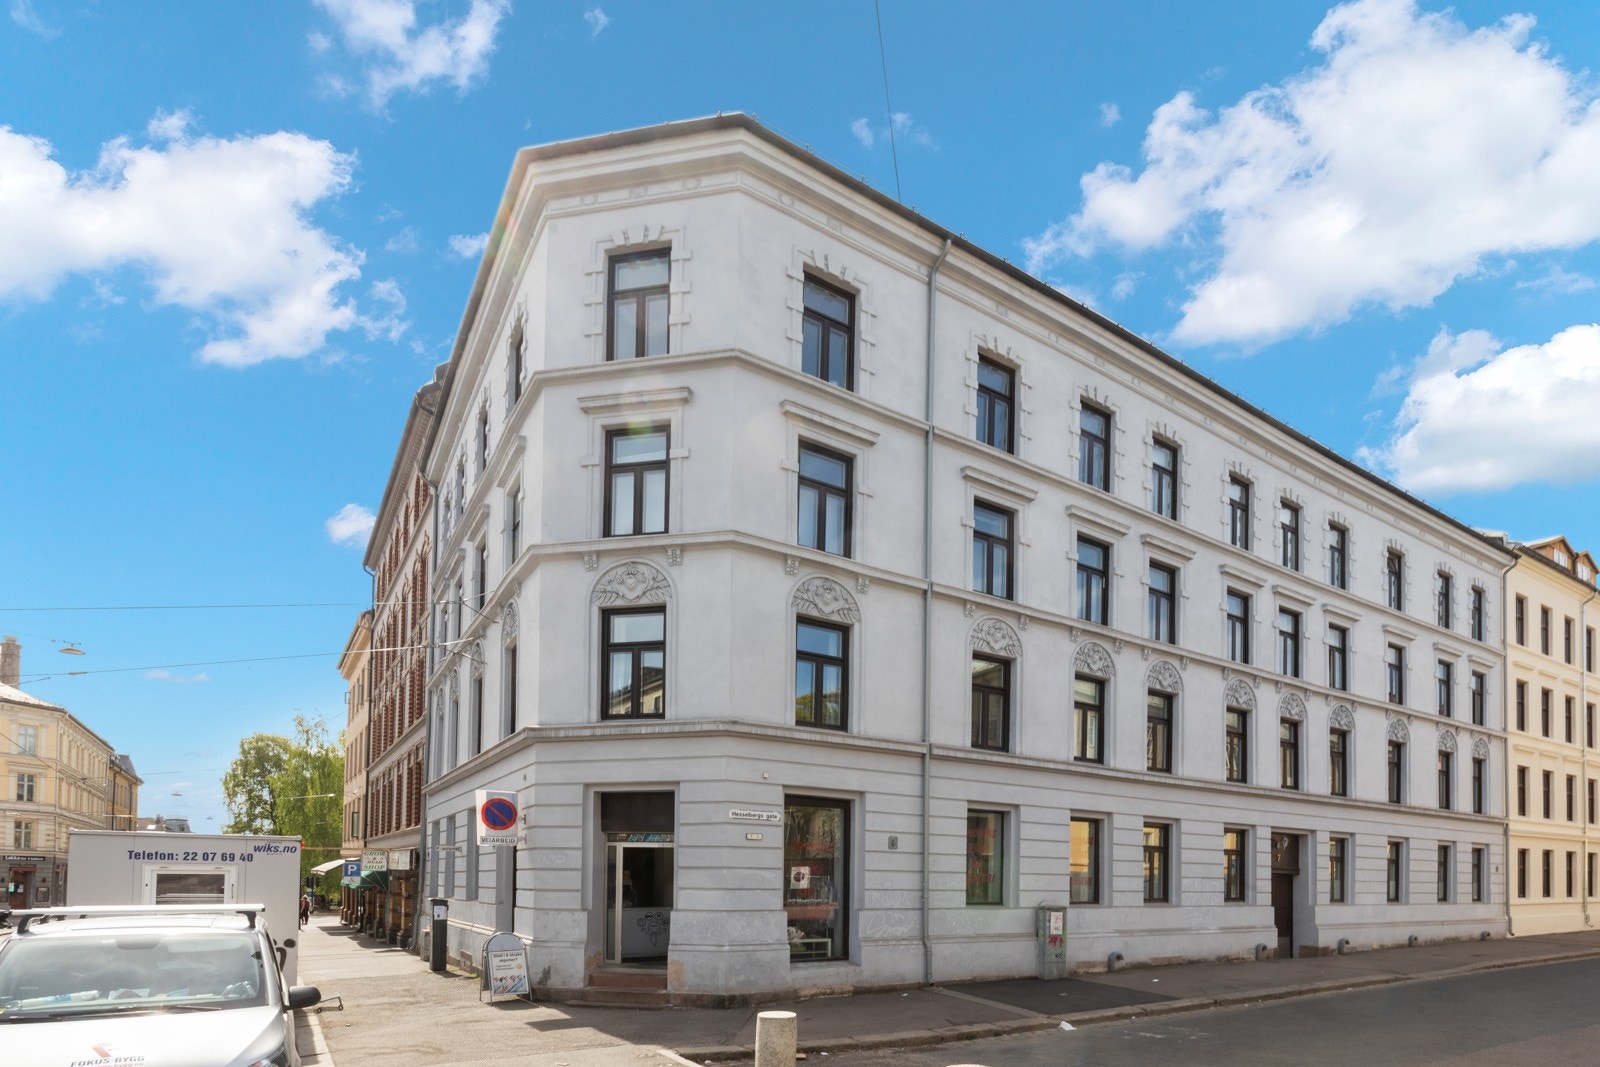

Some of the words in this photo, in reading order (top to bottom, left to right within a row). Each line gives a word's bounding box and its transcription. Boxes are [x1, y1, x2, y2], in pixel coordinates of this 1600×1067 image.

[731, 811, 764, 819] Hesselbergs
[253, 843, 297, 854] wiks.no
[127, 850, 179, 860] Telefon:
[182, 851, 198, 861] 22
[202, 852, 217, 861] 07
[221, 852, 236, 862] 69
[239, 853, 254, 862] 40
[347, 864, 358, 875] P
[70, 1058, 110, 1067] FOKUS
